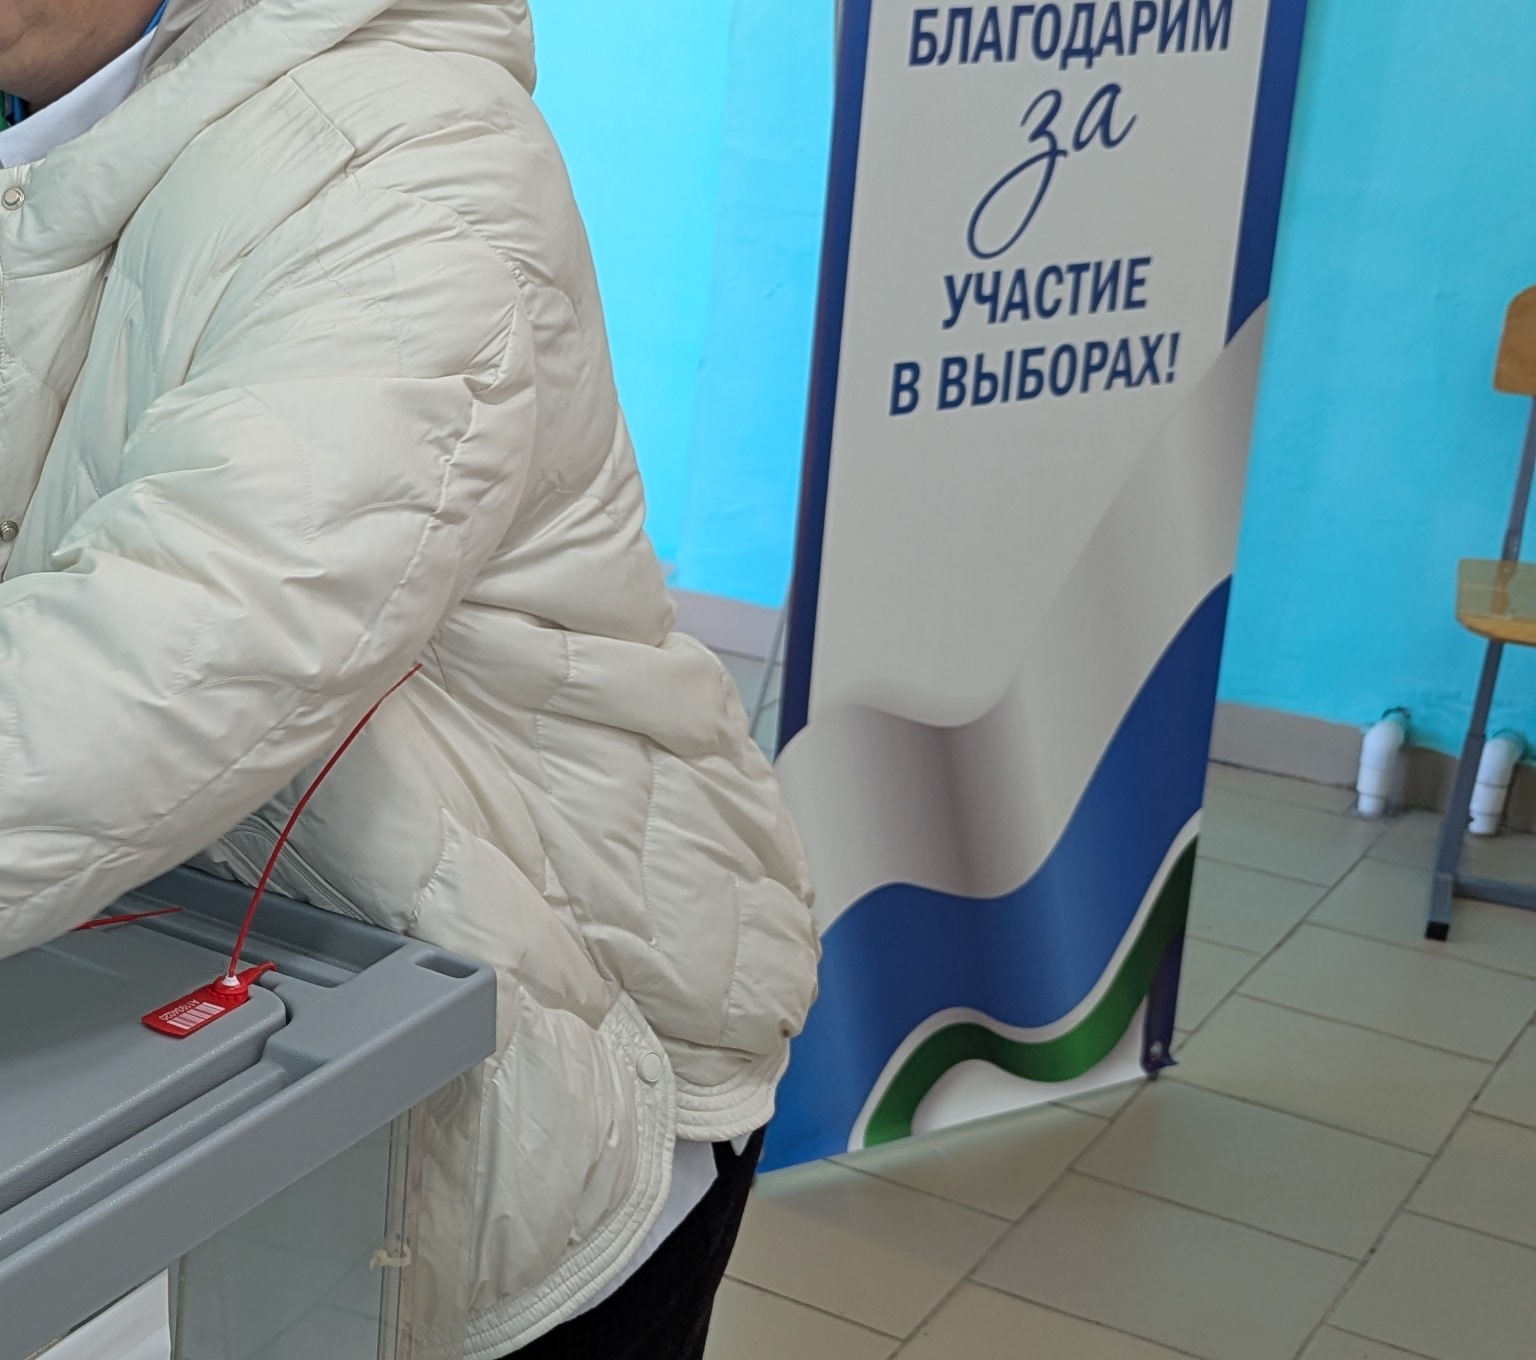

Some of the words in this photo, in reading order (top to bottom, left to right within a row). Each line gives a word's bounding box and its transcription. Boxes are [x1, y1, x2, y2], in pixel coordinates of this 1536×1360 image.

[967, 83, 1136, 259] за
[942, 256, 1151, 329] УЧАСТИЕ
[889, 361, 920, 415] В
[937, 332, 1180, 410] ВЫБОРАХ!
